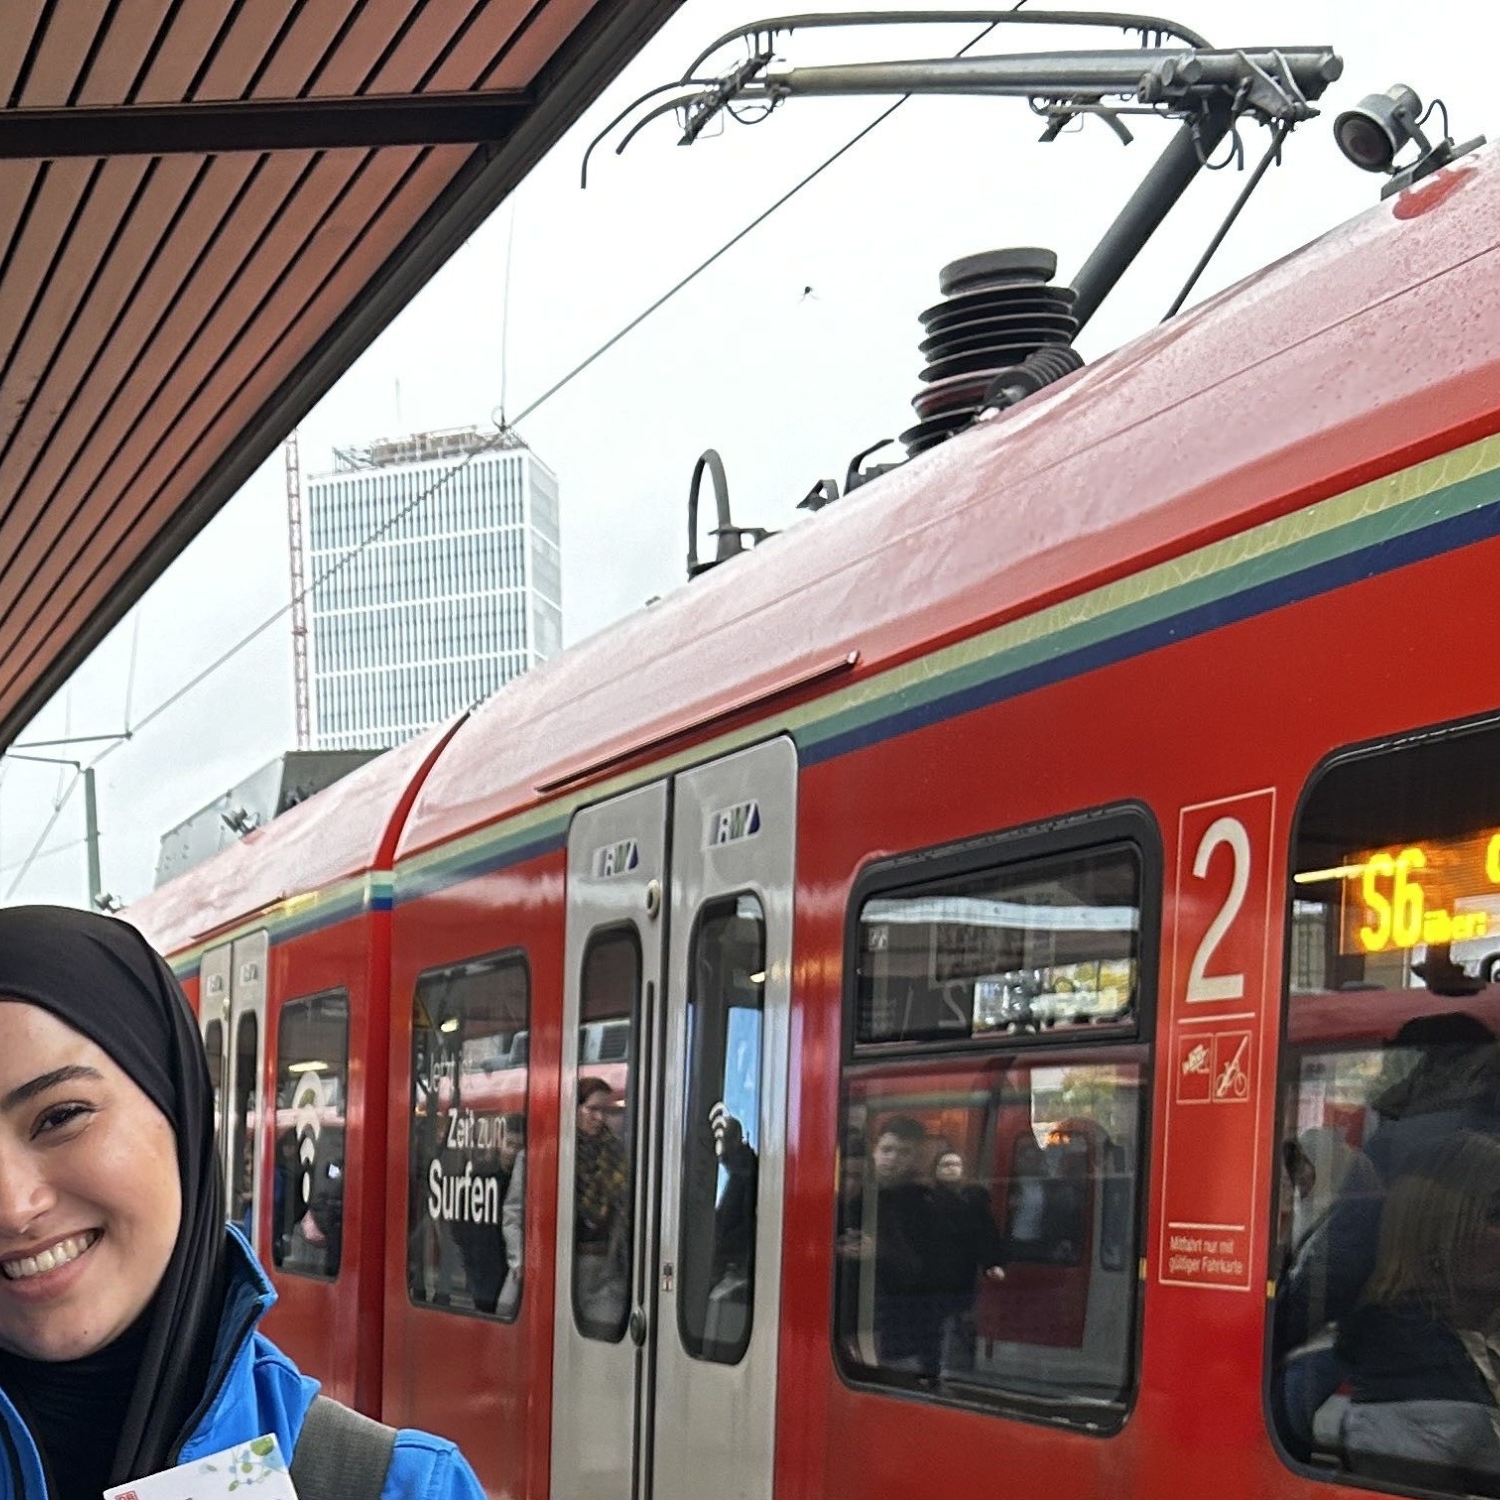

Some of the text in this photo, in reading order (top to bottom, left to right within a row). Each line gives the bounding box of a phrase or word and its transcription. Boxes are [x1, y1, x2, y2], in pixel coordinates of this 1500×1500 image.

[1185, 816, 1251, 1003] 2
[1360, 847, 1427, 951] S6
[446, 1106, 507, 1149] Zeit zum
[428, 1159, 498, 1225] Surfen
